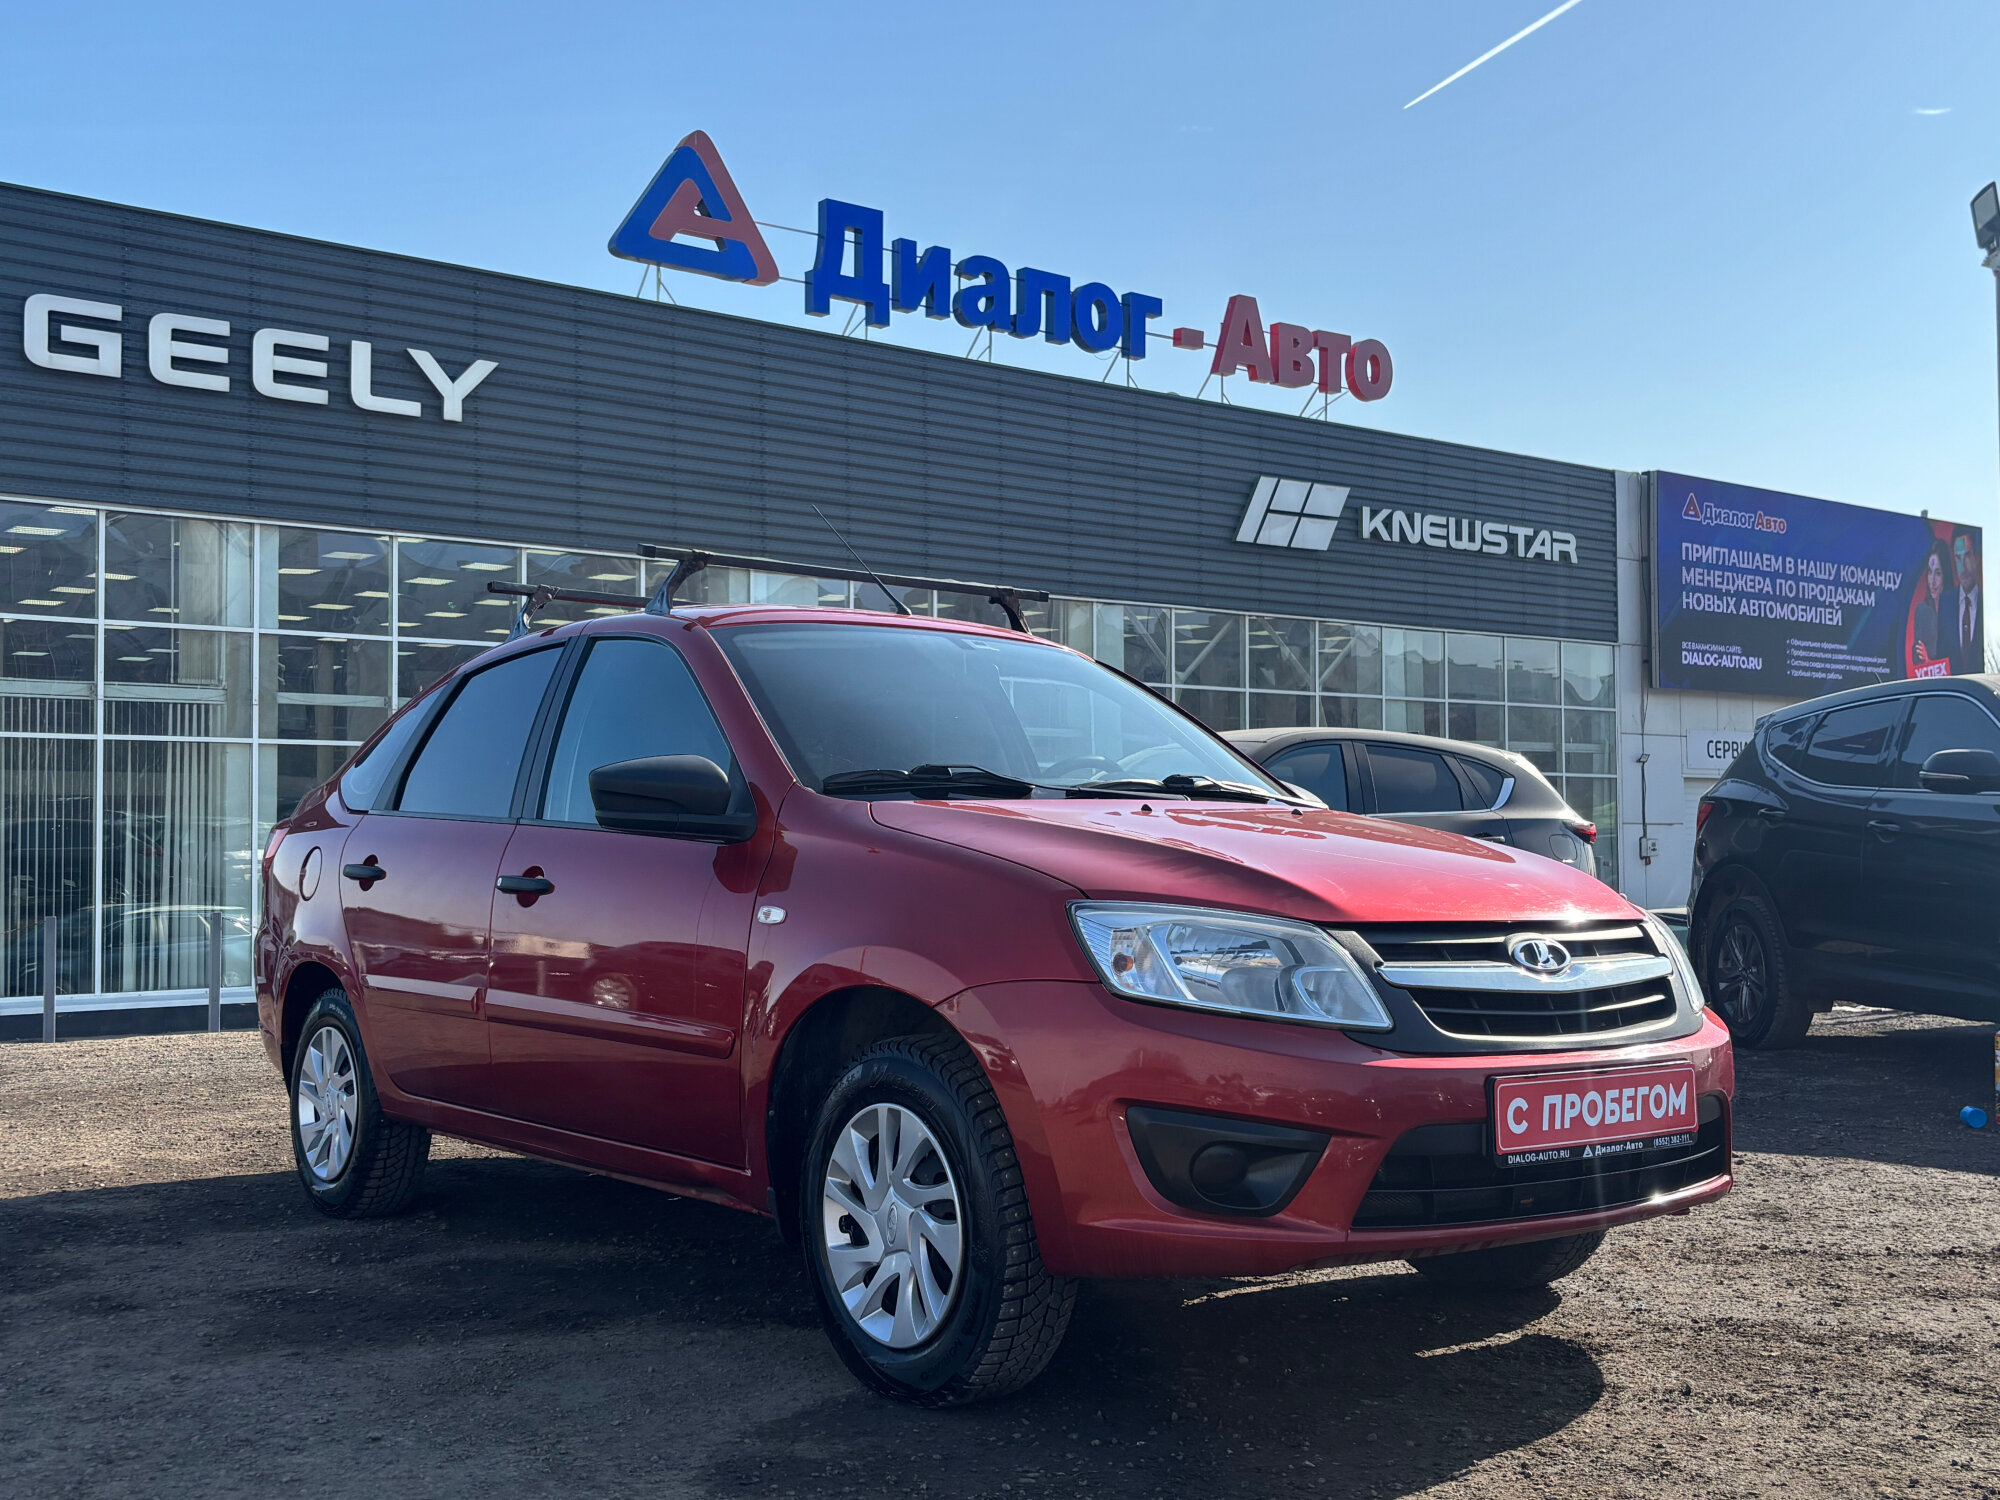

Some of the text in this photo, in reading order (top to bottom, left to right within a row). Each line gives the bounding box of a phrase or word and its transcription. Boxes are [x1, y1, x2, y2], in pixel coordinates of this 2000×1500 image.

[805, 198, 1393, 402] Диалог-Авто
[24, 293, 499, 422] GEELY
[1361, 505, 1578, 564] KNEWSTAR
[1681, 542, 1902, 592] ПРИГЛАШАЕМ В НАШУ КОМАНДУ
[1681, 567, 1876, 607] МЕНЕДЖЕРА ПО ПРОДАЖАМ
[1682, 592, 1843, 626] НОВЫХ АВТОМОБИЛЕЙ
[1682, 651, 1763, 670] DIALOG-AUTO.RU
[1915, 662, 1947, 678] УСПЕХ
[1507, 1081, 1688, 1135] С ПРОБЕГОМ
[1508, 1149, 1570, 1165] DIALOG-AUTO.RU
[1595, 1140, 1644, 1157] Диалог-Авто
